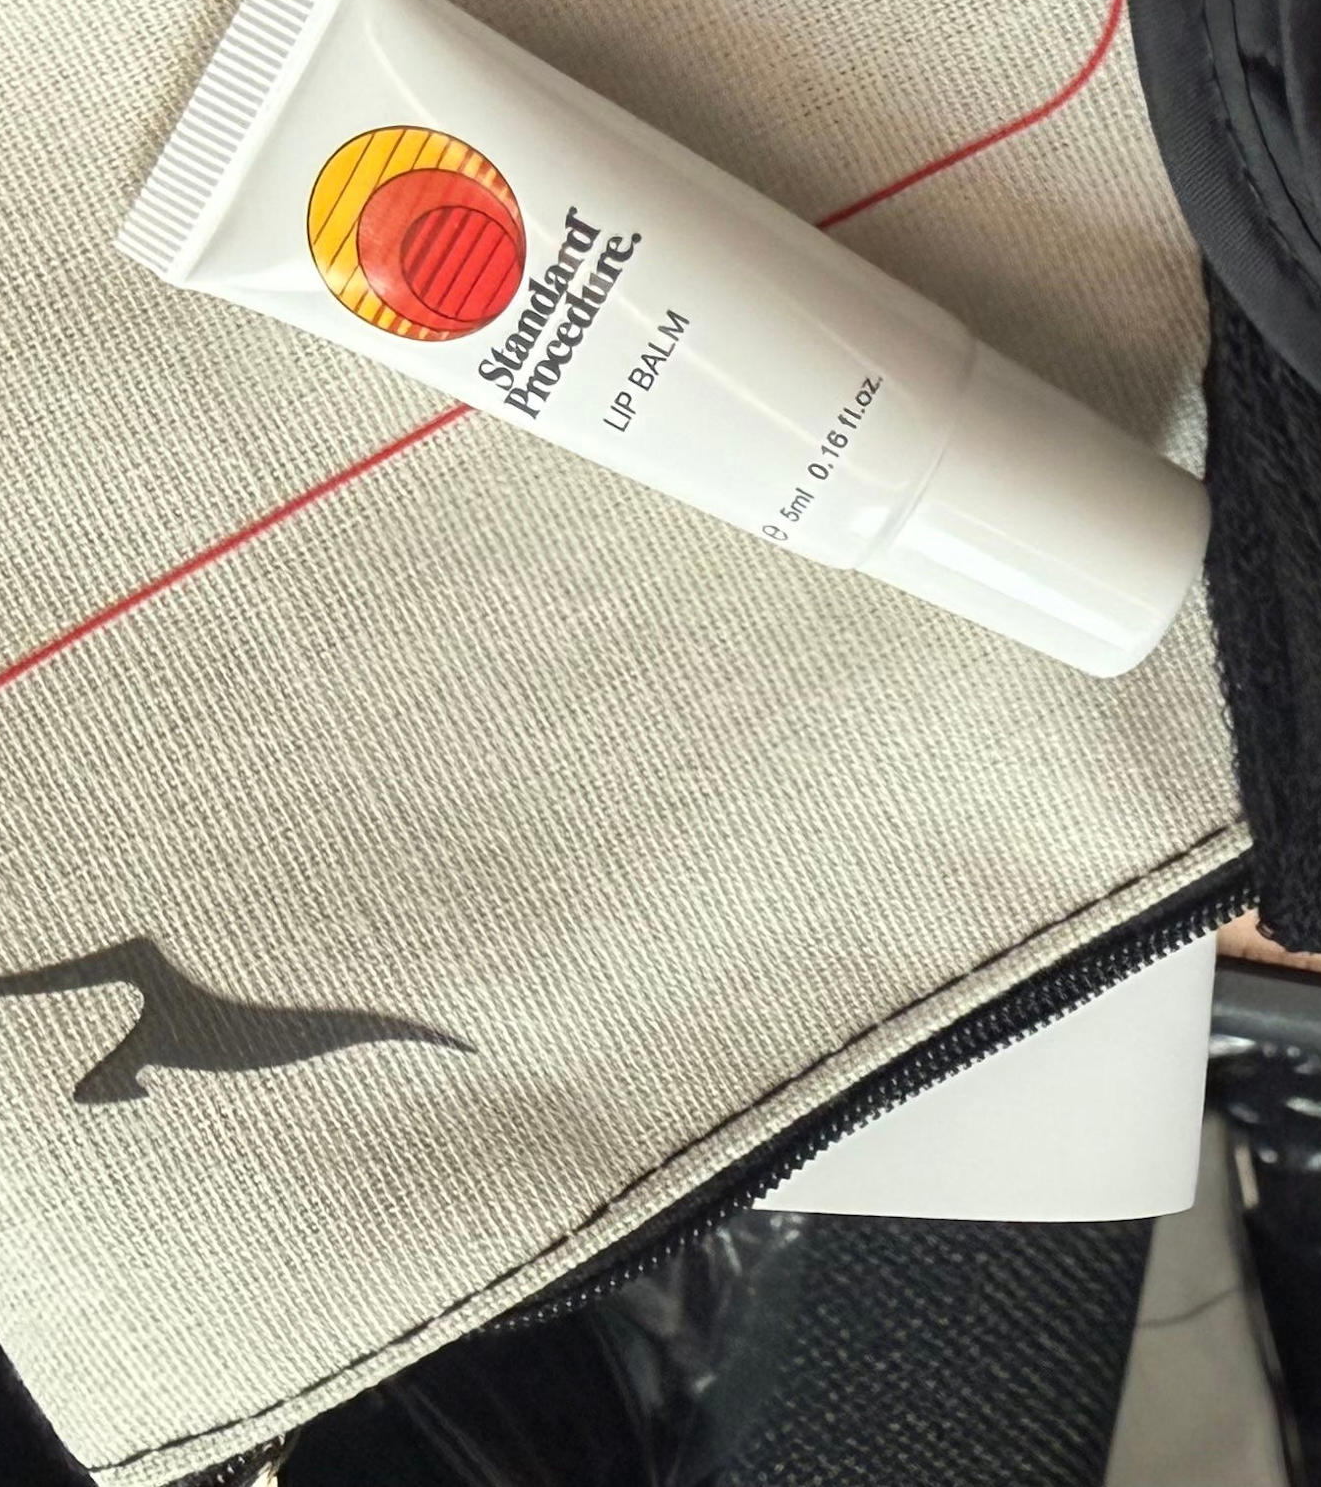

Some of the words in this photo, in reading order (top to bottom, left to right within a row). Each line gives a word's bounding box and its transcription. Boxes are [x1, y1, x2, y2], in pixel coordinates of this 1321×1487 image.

[477, 205, 601, 392] Standard
[504, 231, 642, 420] Procedure.
[603, 391, 636, 432] LIP
[628, 309, 690, 391] BALM
[780, 487, 814, 522] 5ml
[807, 430, 848, 480] 0.16
